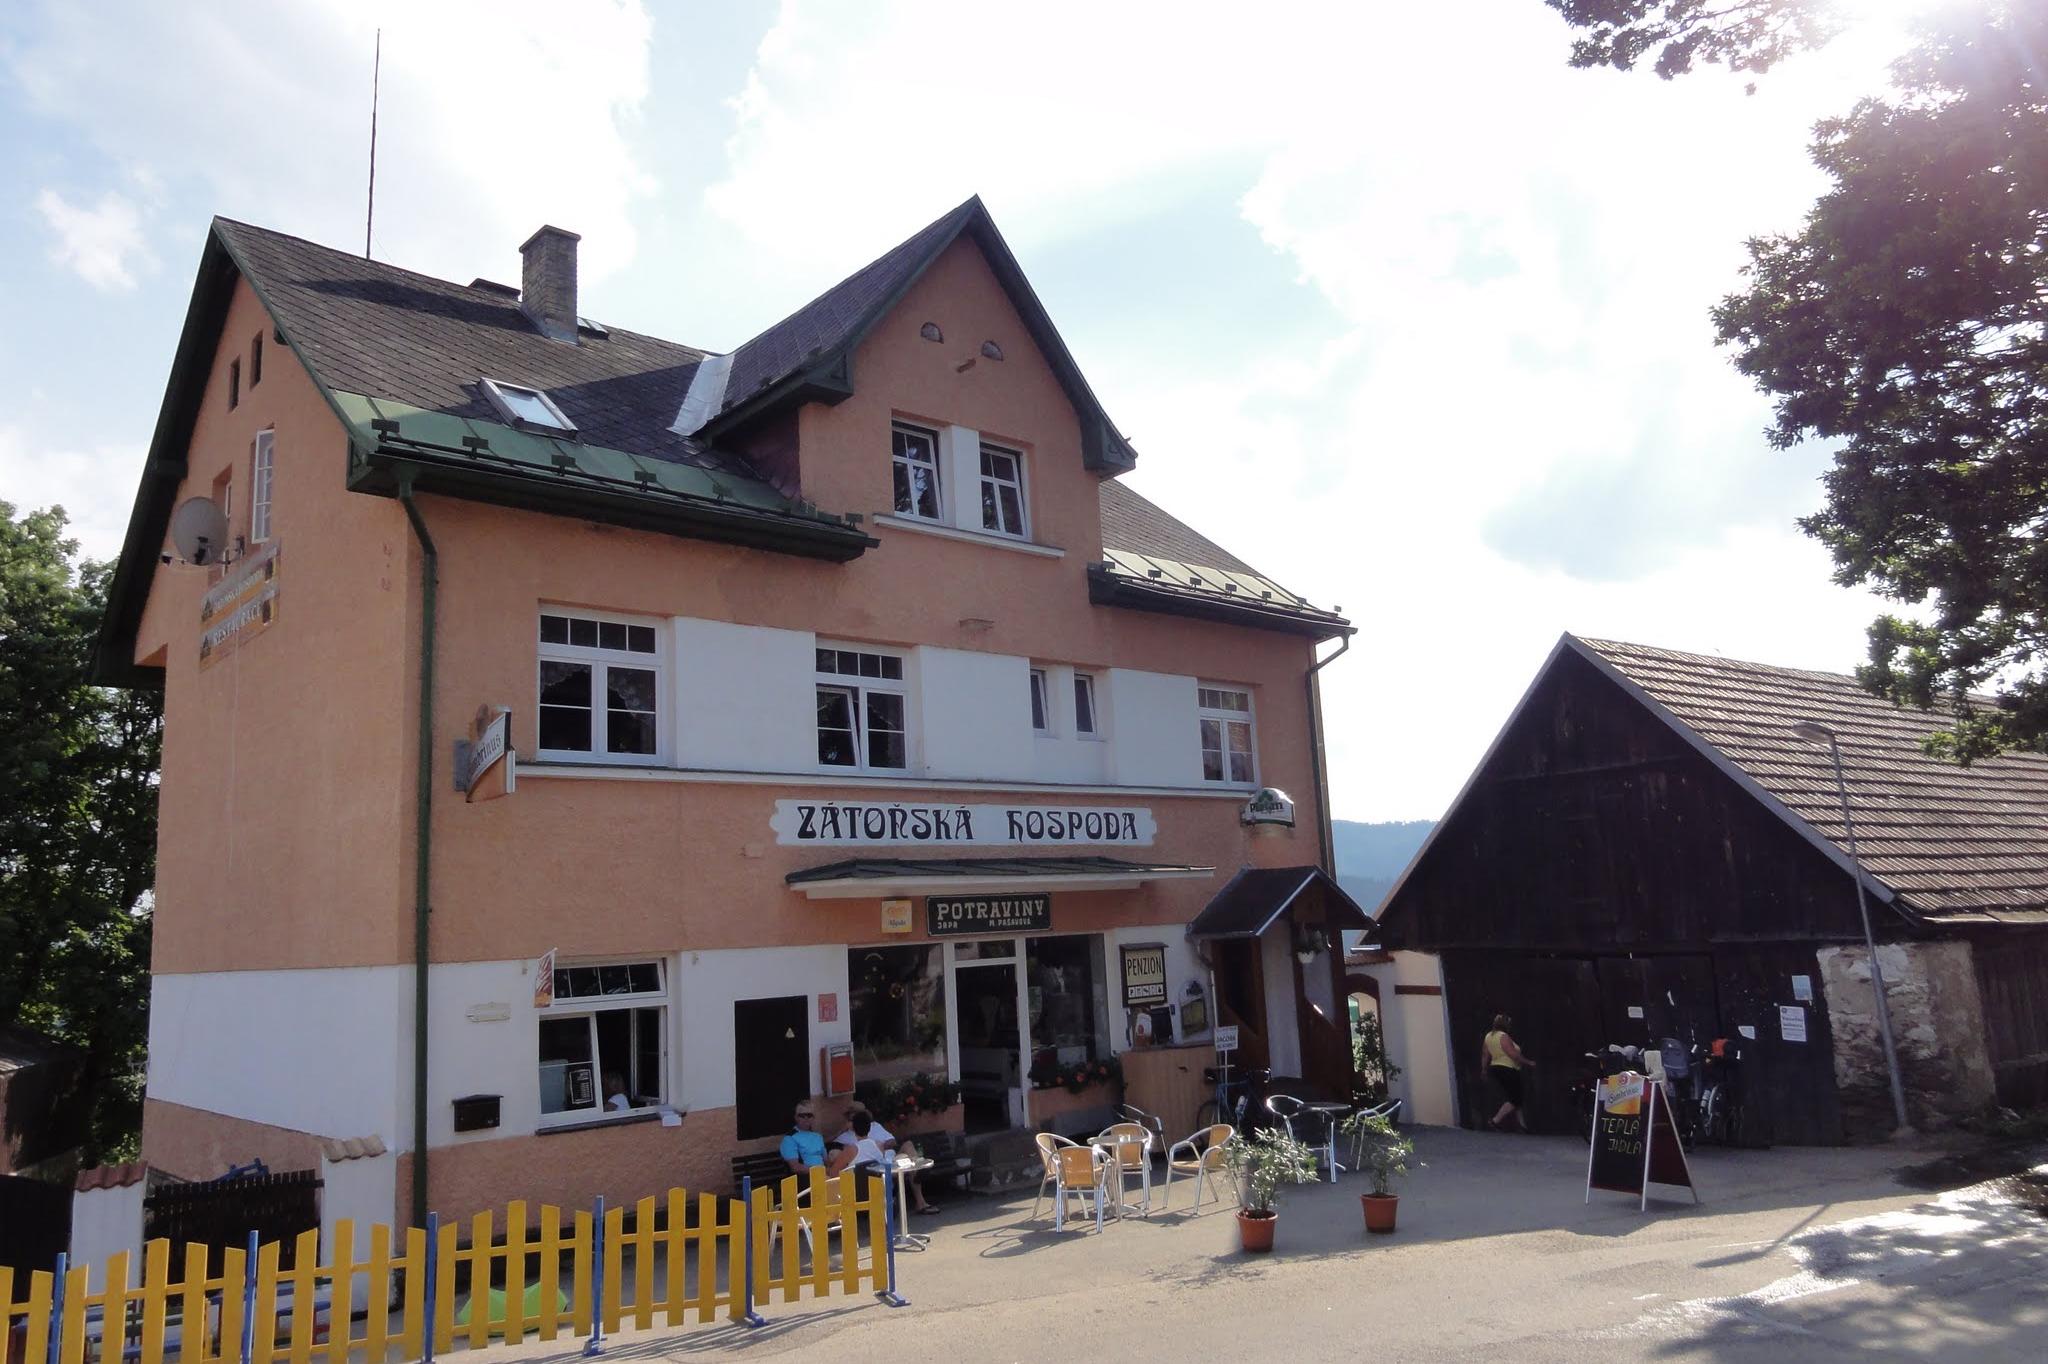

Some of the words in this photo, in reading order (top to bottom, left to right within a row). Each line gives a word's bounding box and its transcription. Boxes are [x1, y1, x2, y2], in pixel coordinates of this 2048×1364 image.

[797, 801, 974, 841] ZÁTOŇSKÁ
[1005, 809, 1138, 843] HOSPODA
[936, 899, 1045, 921] POTRAVINY
[1126, 956, 1163, 976] PENZION
